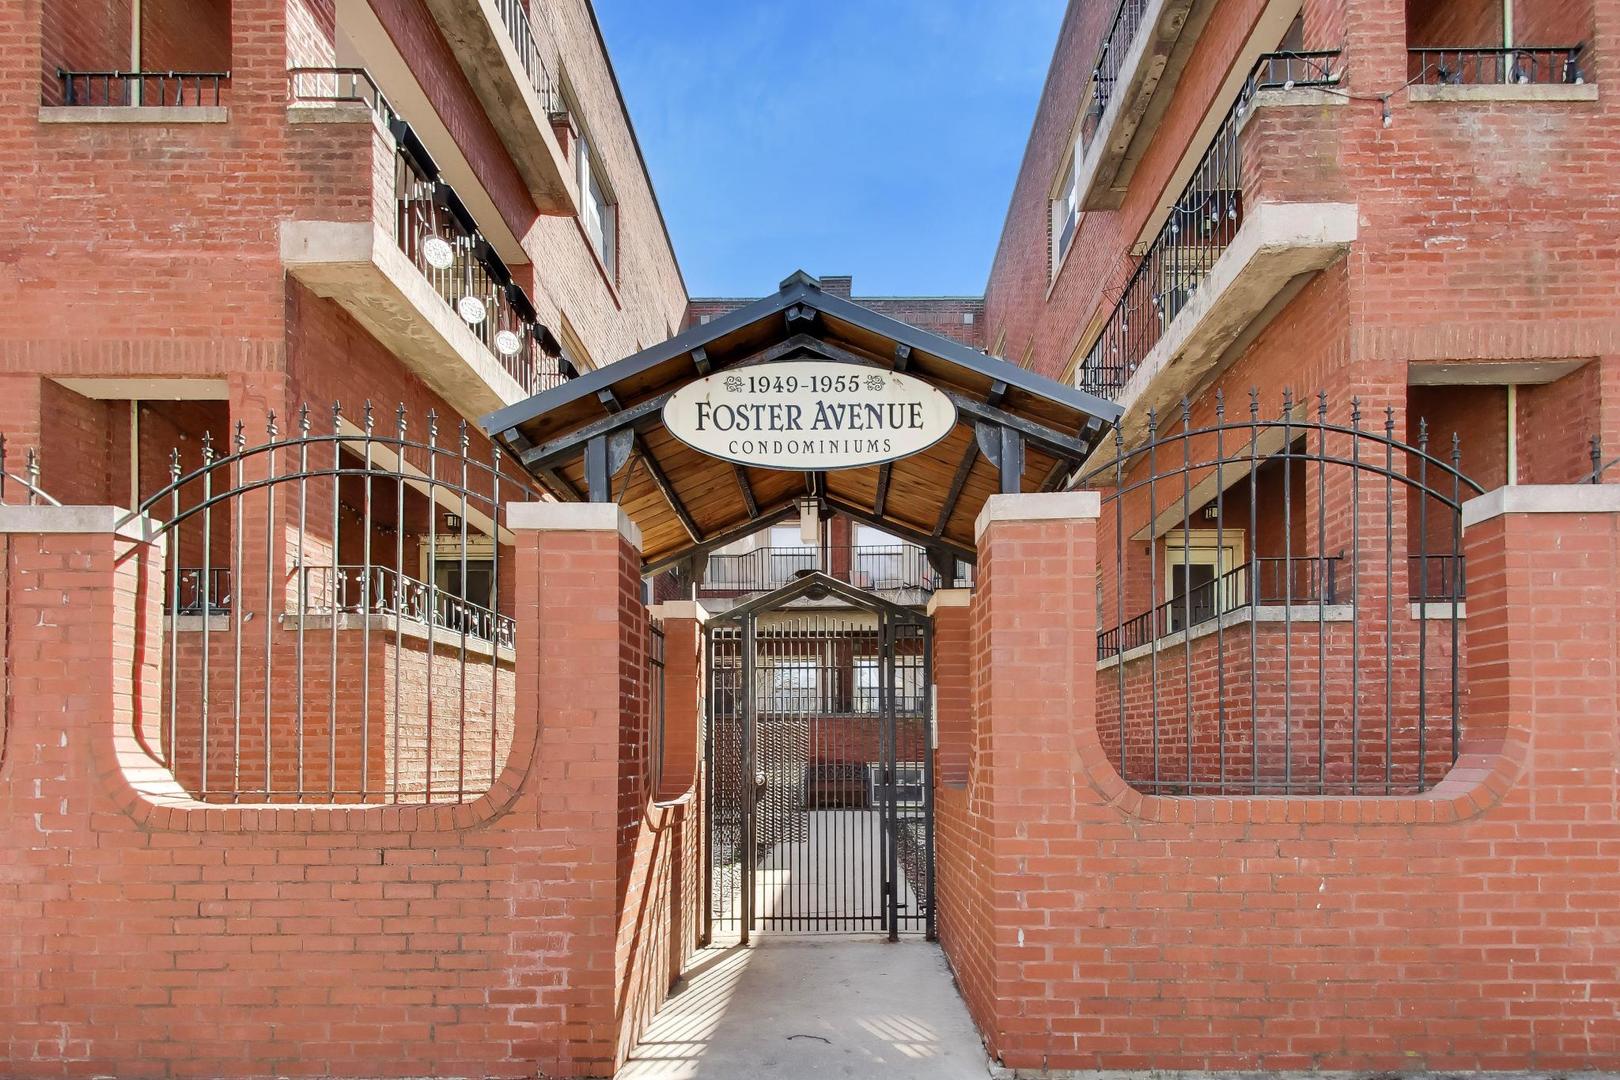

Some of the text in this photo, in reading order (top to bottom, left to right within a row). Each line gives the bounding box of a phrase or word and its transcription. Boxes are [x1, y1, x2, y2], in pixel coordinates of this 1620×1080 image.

[748, 375, 860, 393] 1949-1955
[695, 400, 924, 432] FOSTER AVENUE
[729, 439, 891, 454] CONDOMINIUMS
